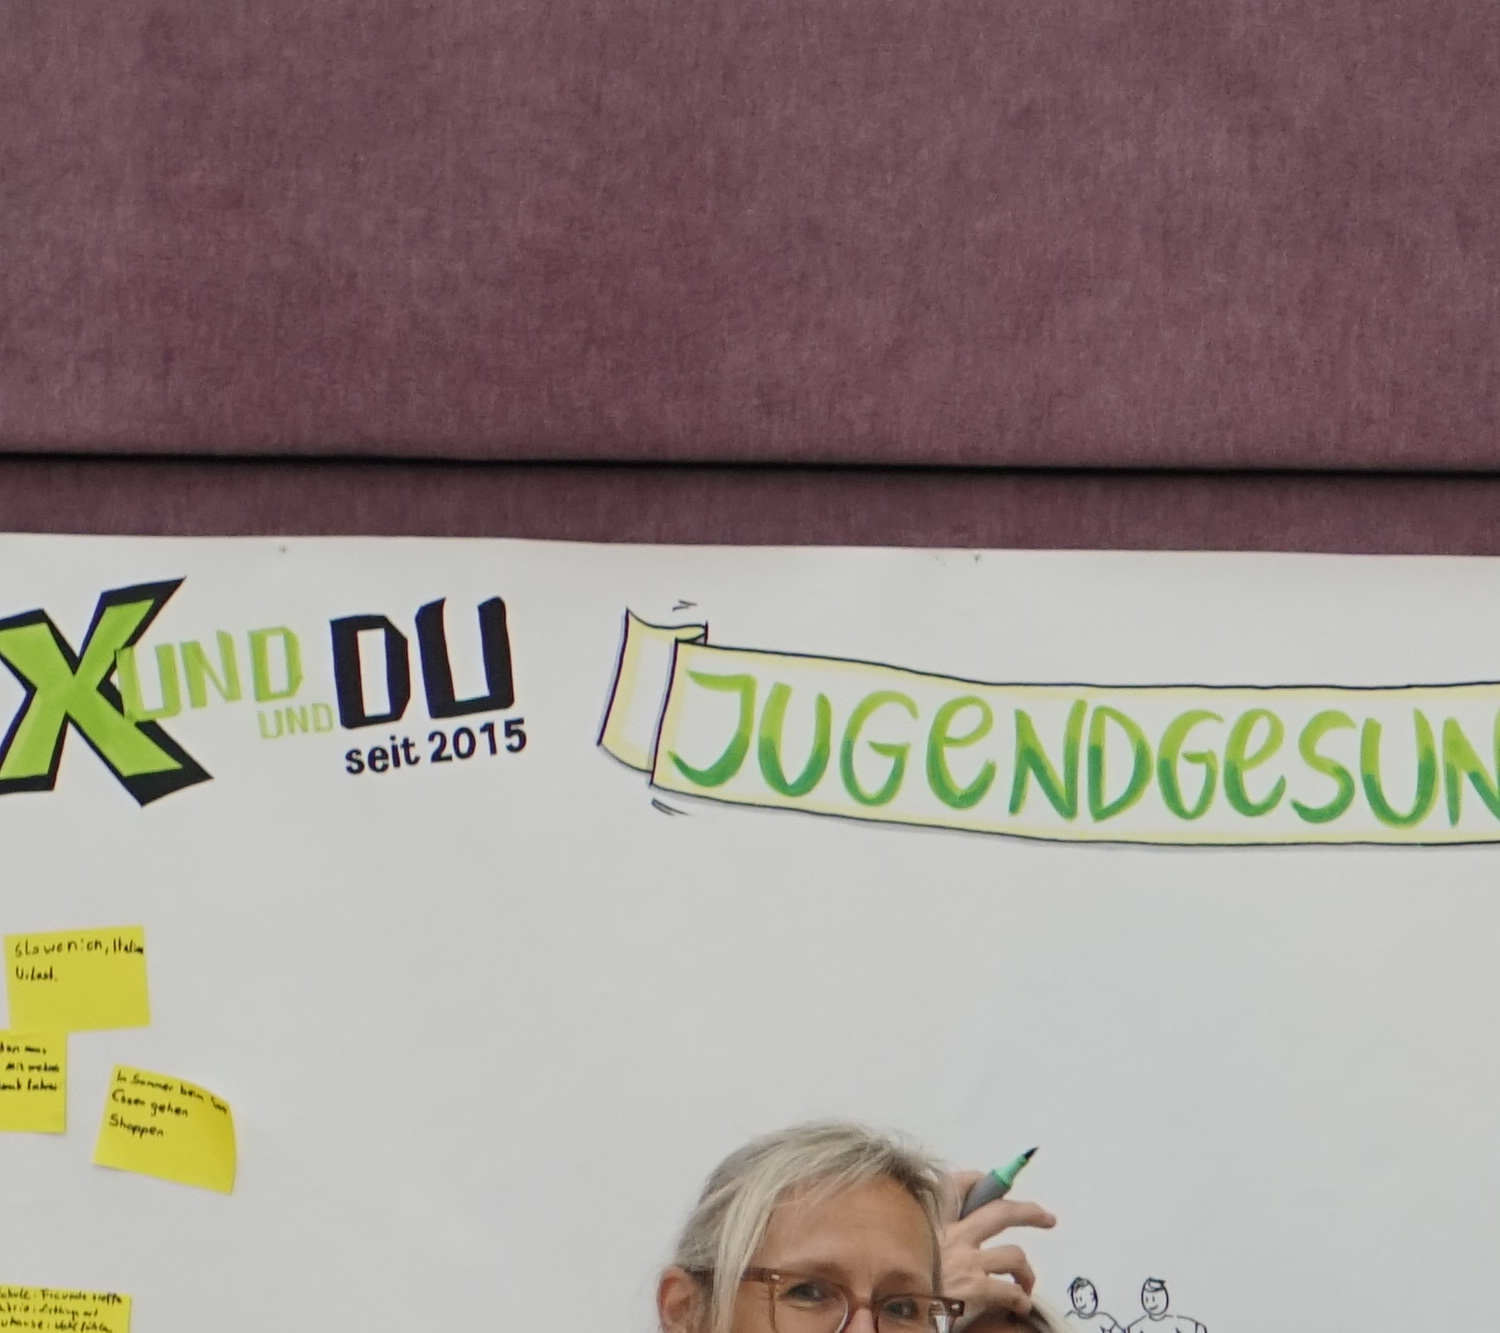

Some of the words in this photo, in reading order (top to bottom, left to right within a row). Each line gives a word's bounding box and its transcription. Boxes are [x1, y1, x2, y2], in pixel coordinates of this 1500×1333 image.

[329, 596, 515, 729] DU
[345, 735, 420, 775] seit
[428, 717, 527, 764] 2015
